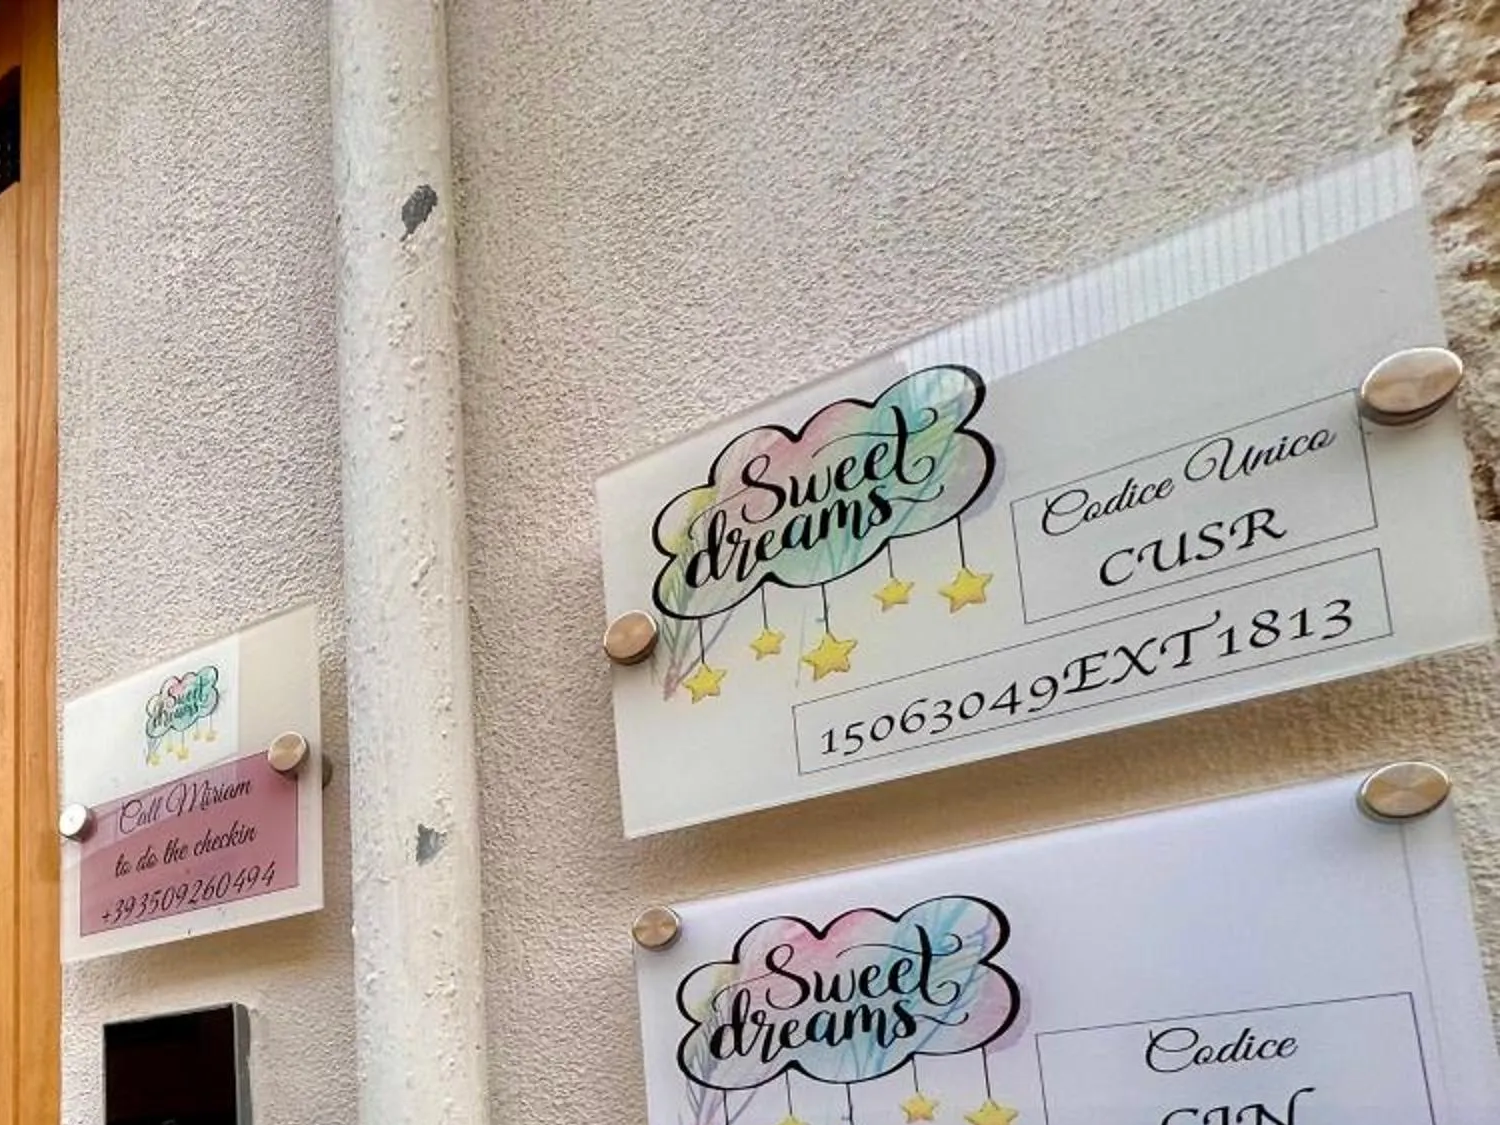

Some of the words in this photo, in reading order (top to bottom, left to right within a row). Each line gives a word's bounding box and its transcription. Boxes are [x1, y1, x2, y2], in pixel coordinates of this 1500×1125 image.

[738, 406, 938, 523] Sweet
[1041, 476, 1175, 537] Codice
[1183, 428, 1336, 482] Unico
[685, 485, 943, 589] dreams
[1099, 506, 1288, 587] CUSR
[820, 598, 1354, 756] 15063049EXT1813
[119, 796, 163, 834] Call
[165, 779, 252, 817] Miriam
[115, 853, 132, 878] to
[136, 845, 159, 873] do
[163, 837, 189, 865] the
[193, 819, 257, 857] checkin
[101, 861, 276, 923] +393509260494
[764, 924, 964, 1010] Sweet
[709, 988, 969, 1063] dreams
[1145, 1026, 1299, 1073] Codice
